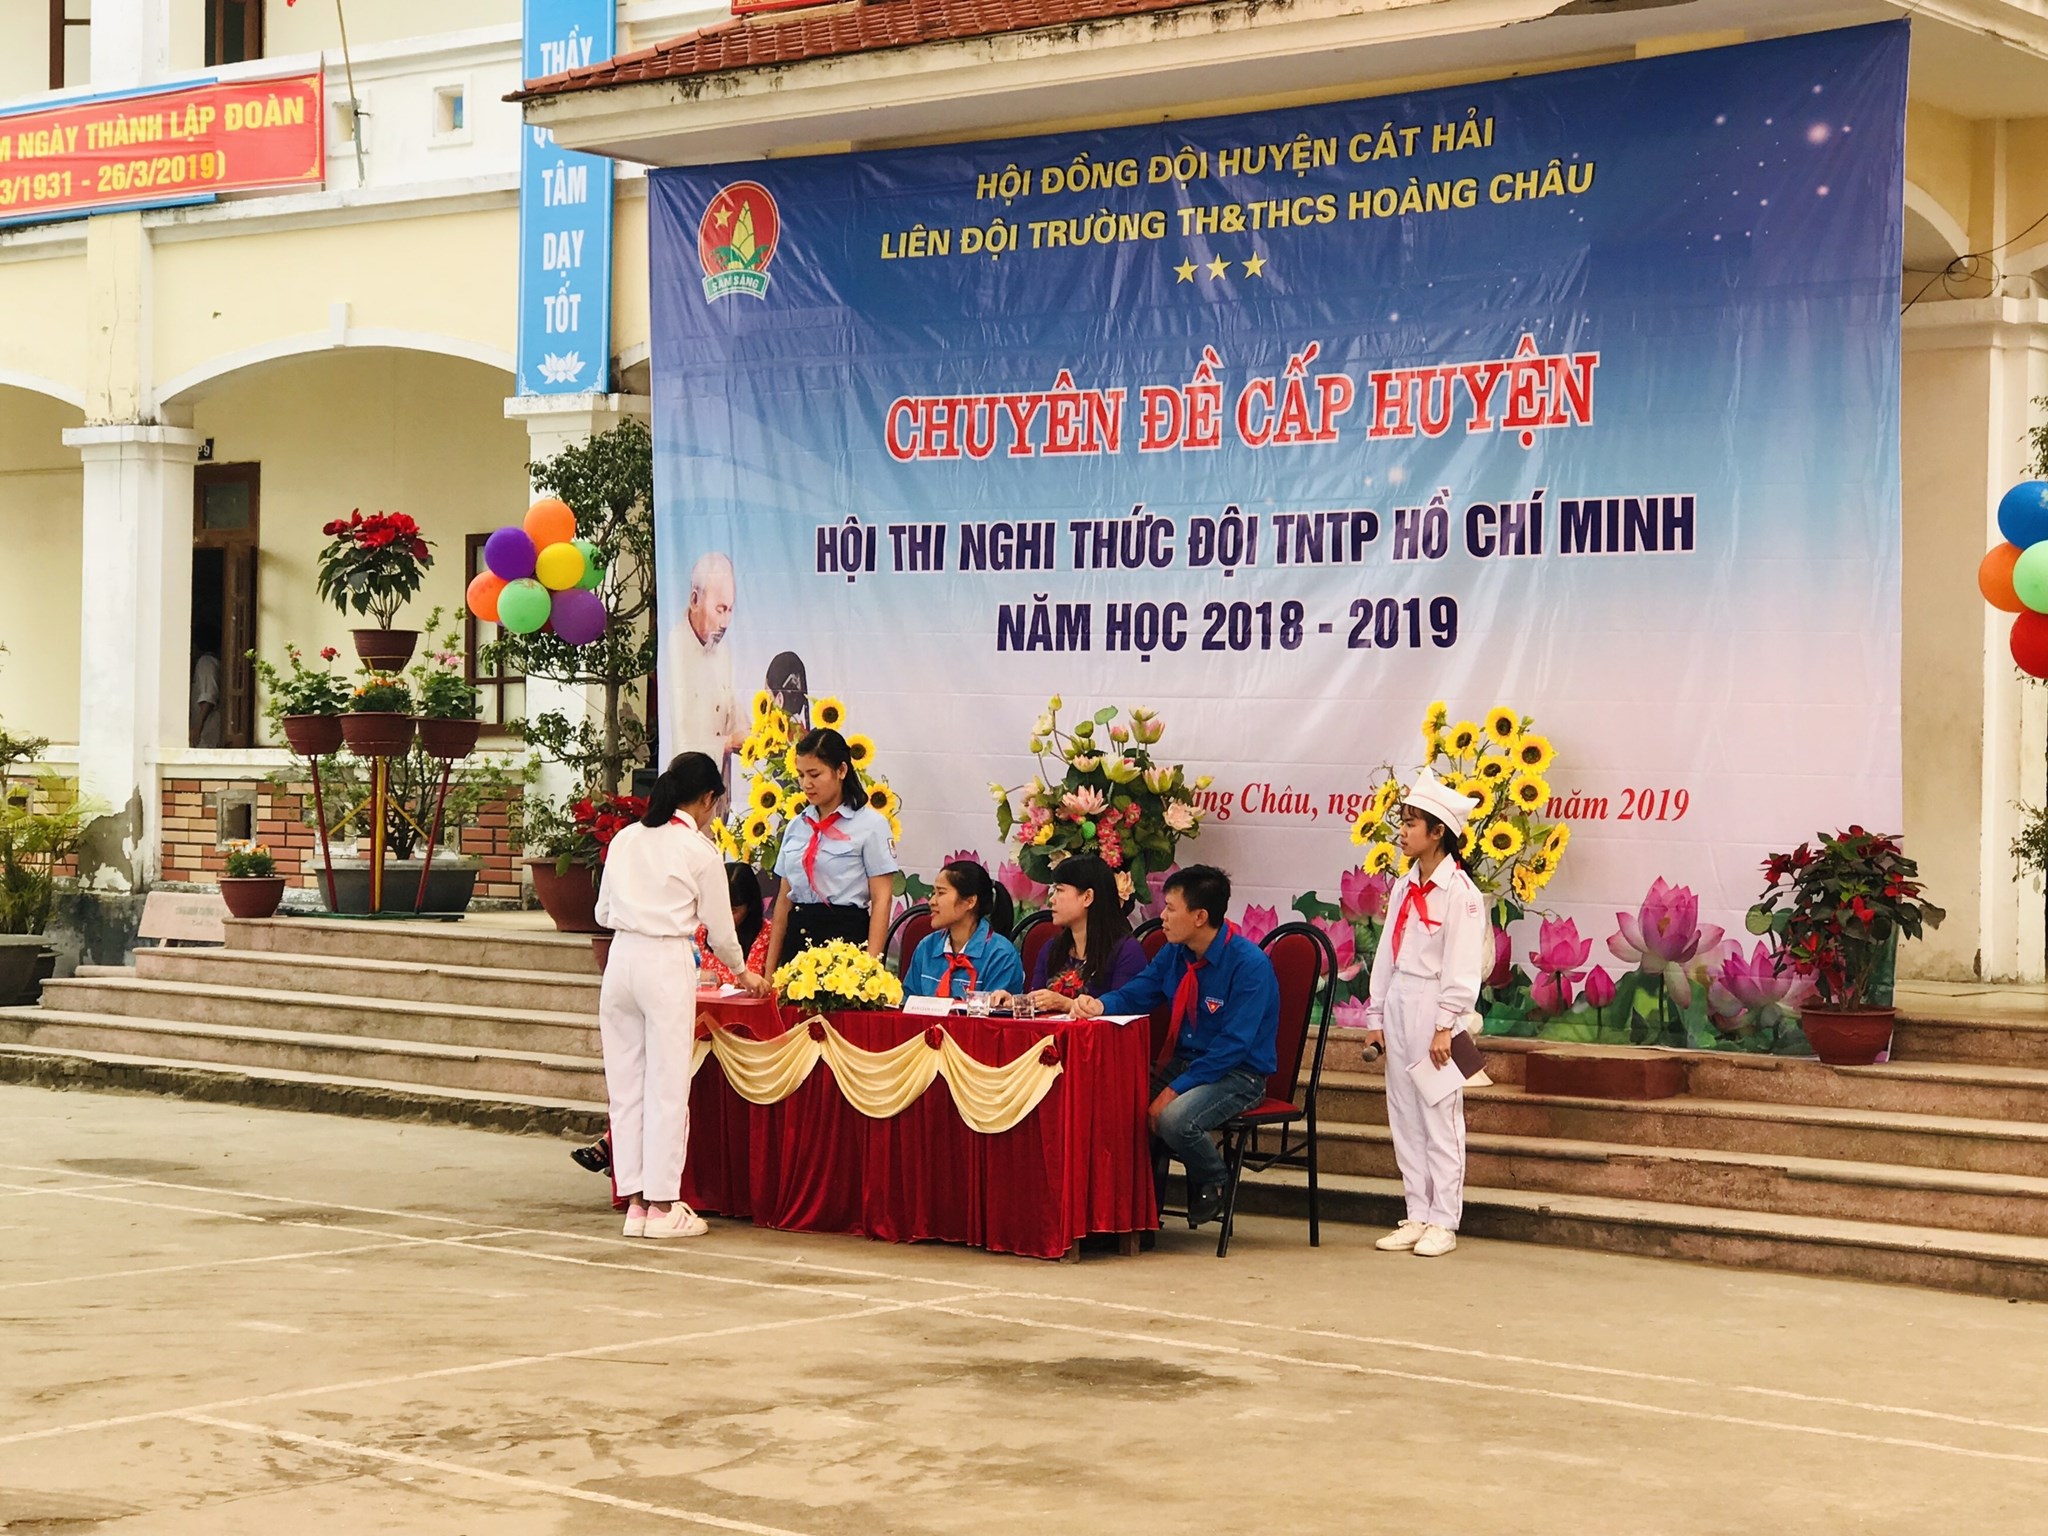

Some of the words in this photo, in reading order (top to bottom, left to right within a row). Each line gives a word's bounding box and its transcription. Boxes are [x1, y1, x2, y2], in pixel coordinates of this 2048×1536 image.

[17, 123, 79, 159] NGÀY
[85, 113, 163, 150] THÀNH
[170, 102, 215, 142] LẬP
[224, 94, 304, 131] ĐOÀN
[976, 162, 1031, 207] HỘI
[1041, 151, 1139, 195] ĐỒNG
[1149, 144, 1209, 190] ĐỘI
[1218, 133, 1337, 179] HUYỆN
[1348, 122, 1421, 160] CÁT
[1431, 107, 1495, 154] HẢI
[97, 150, 226, 192] 26/3/2019)
[541, 160, 587, 208] TÂM
[881, 222, 951, 260] LIÊN
[960, 217, 1018, 261] ĐỘI
[1028, 208, 1166, 249] TRƯỜNG
[1177, 193, 1337, 236] TH&THCS
[1349, 176, 1478, 219] HOÀNG
[1489, 156, 1595, 202] CHÂU
[543, 230, 585, 279] DẠY
[544, 281, 582, 334] TỐT
[885, 369, 1127, 462] CHUYÊN
[1139, 345, 1224, 452] ĐỀ
[1235, 341, 1353, 447] CẤP
[1366, 333, 1600, 449] HUYỆN
[815, 515, 877, 584] HỘI
[887, 522, 947, 573] THI
[958, 520, 1057, 573] NGHI
[1068, 503, 1176, 571] THỨC
[1187, 504, 1260, 577] ĐỘI
[1271, 508, 1380, 567] TNTP
[1392, 486, 1452, 562] HỒ
[1464, 487, 1548, 560] CHÍ
[1558, 493, 1697, 557] MINH
[996, 593, 1092, 652] NĂM
[1105, 601, 1188, 663] HỌC
[1201, 600, 1305, 652] 2018
[1347, 596, 1458, 650] 2019
[1240, 782, 1318, 822] Châu,
[1545, 788, 1608, 820] năm
[1617, 788, 1690, 821] 2019
